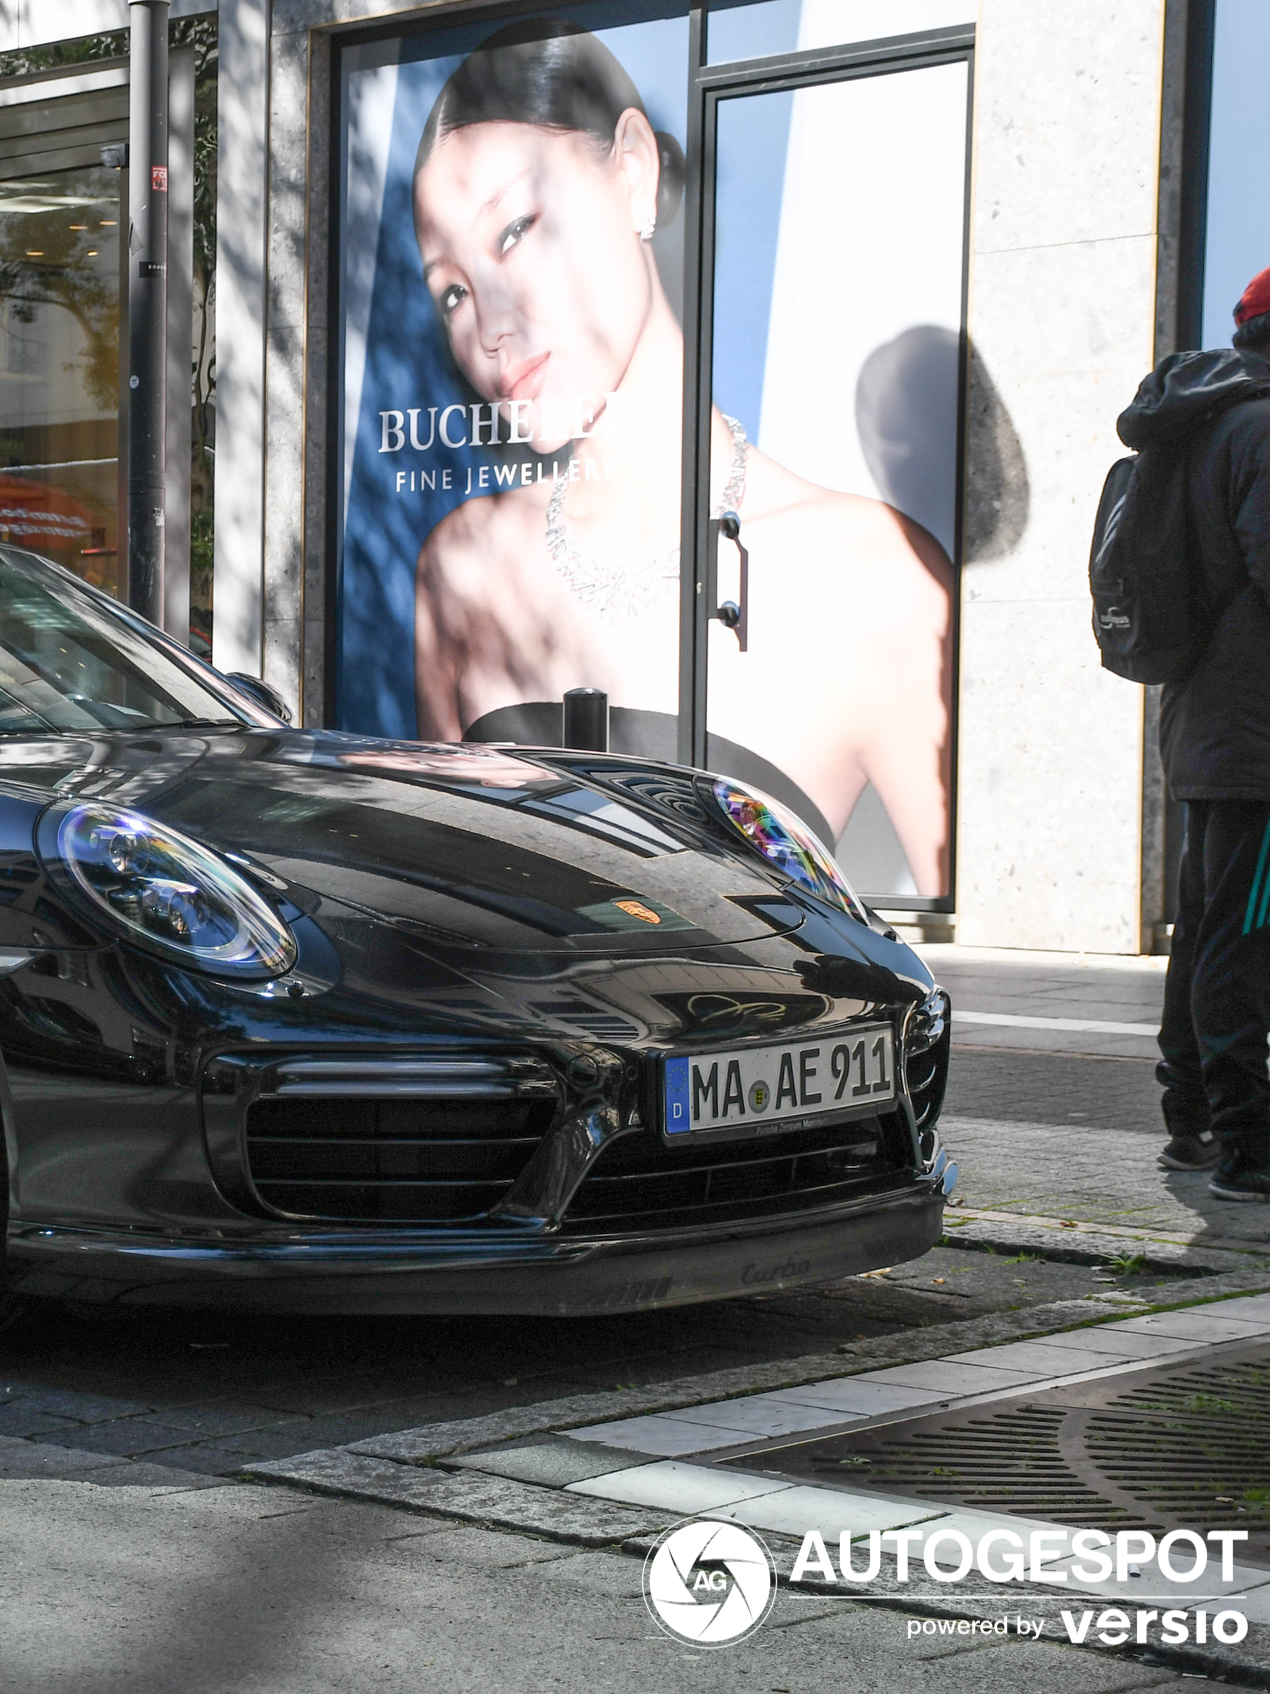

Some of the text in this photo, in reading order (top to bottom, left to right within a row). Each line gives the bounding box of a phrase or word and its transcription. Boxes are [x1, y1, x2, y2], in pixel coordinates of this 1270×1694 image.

[395, 457, 615, 495] FINE JEWELLERY
[673, 1036, 891, 1121] D MA AE 911
